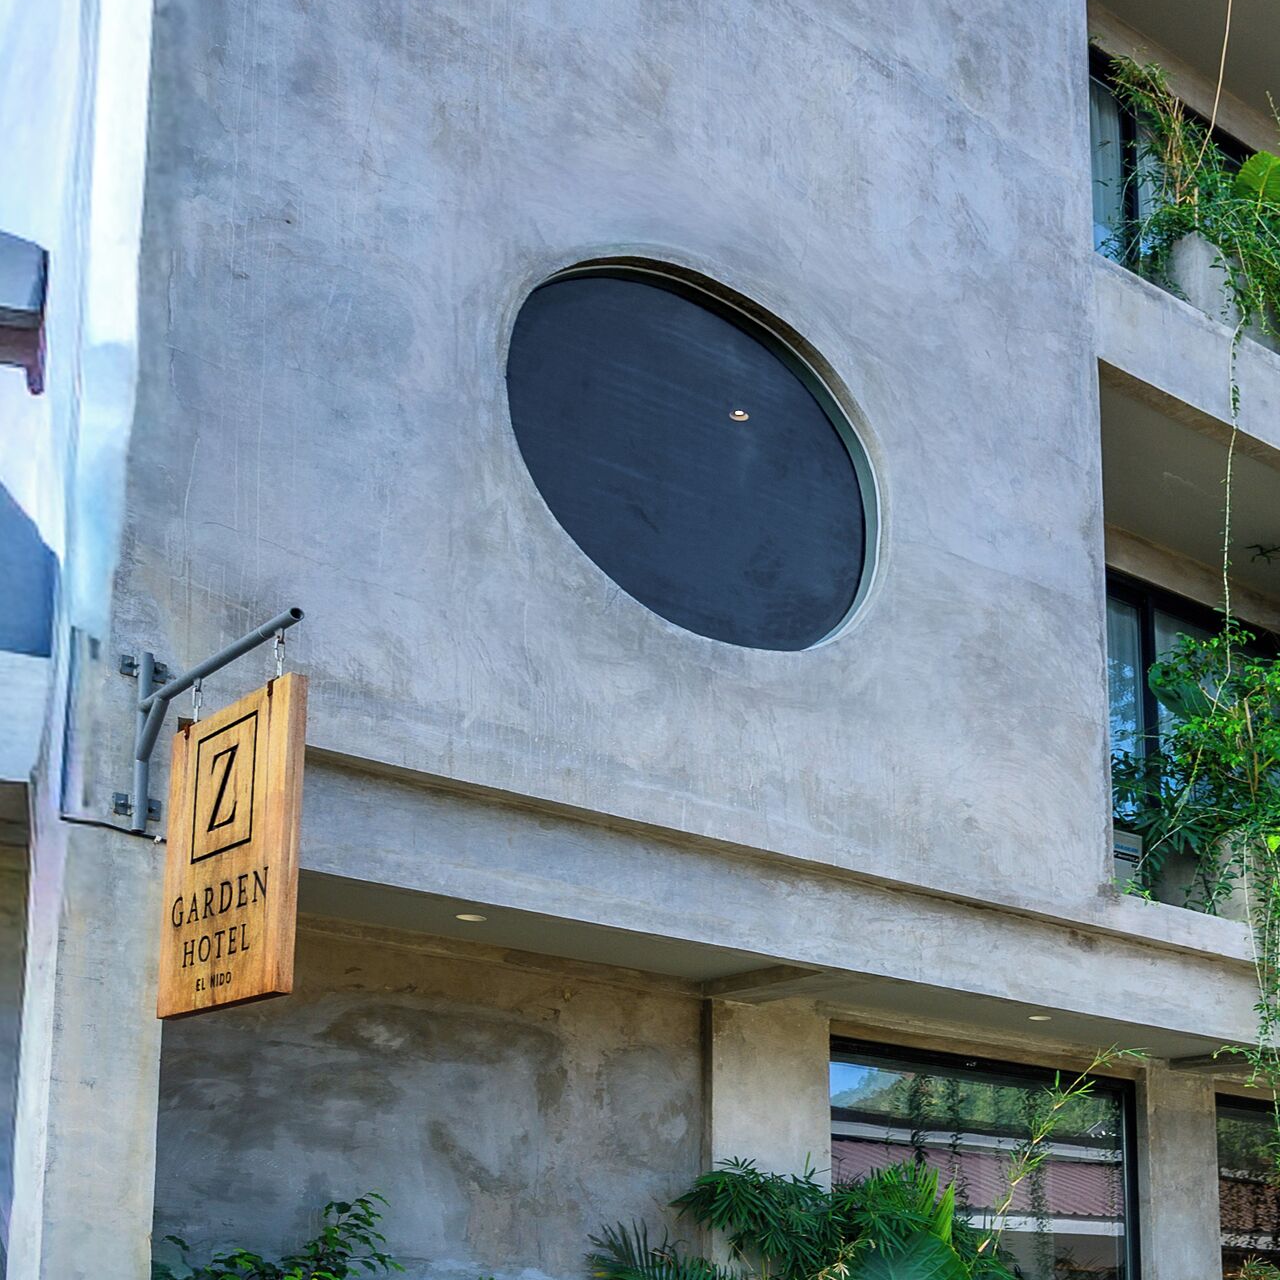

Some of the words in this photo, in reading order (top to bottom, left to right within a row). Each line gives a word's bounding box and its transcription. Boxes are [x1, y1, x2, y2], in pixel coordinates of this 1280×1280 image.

[207, 743, 239, 833] Z
[171, 865, 269, 928] GARDEN
[182, 923, 250, 969] HOTEL
[195, 977, 206, 992] EL
[210, 971, 232, 989] NIDO
